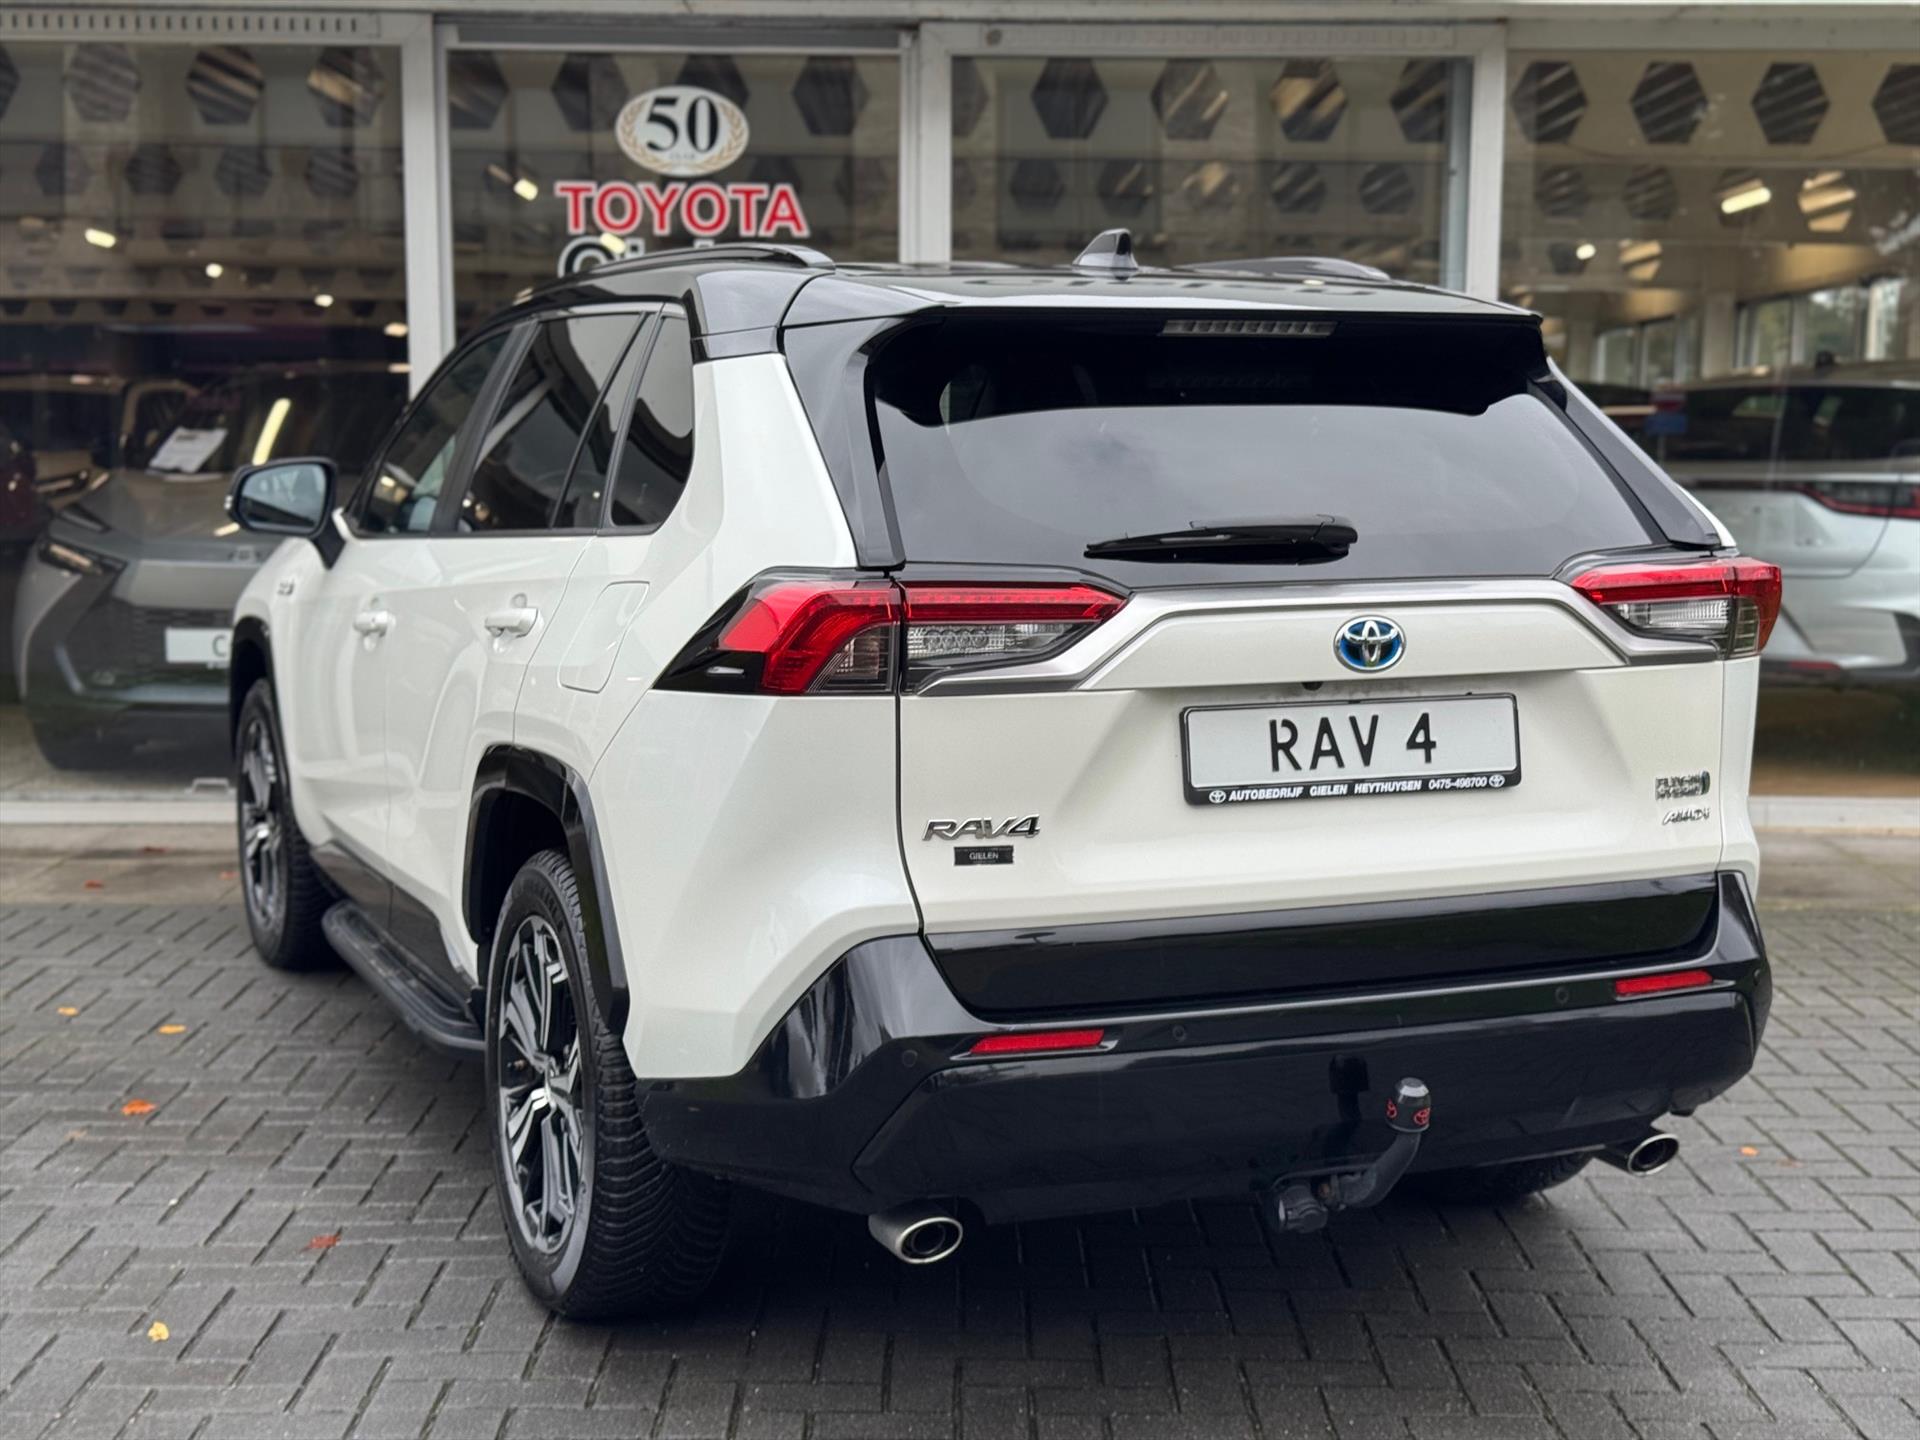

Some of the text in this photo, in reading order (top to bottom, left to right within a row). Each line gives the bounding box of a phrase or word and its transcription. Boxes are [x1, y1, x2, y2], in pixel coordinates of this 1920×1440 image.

[646, 96, 719, 152] 50
[555, 181, 809, 237] TOYOTA
[1269, 712, 1437, 773] RAV 4
[1228, 786, 1304, 802] AUTOBEDRIJF
[1309, 783, 1349, 797] GIELEN
[1354, 779, 1423, 795] HEYTHUYSEN
[922, 813, 1041, 842] RAV4
[969, 851, 999, 861] GIELEN
